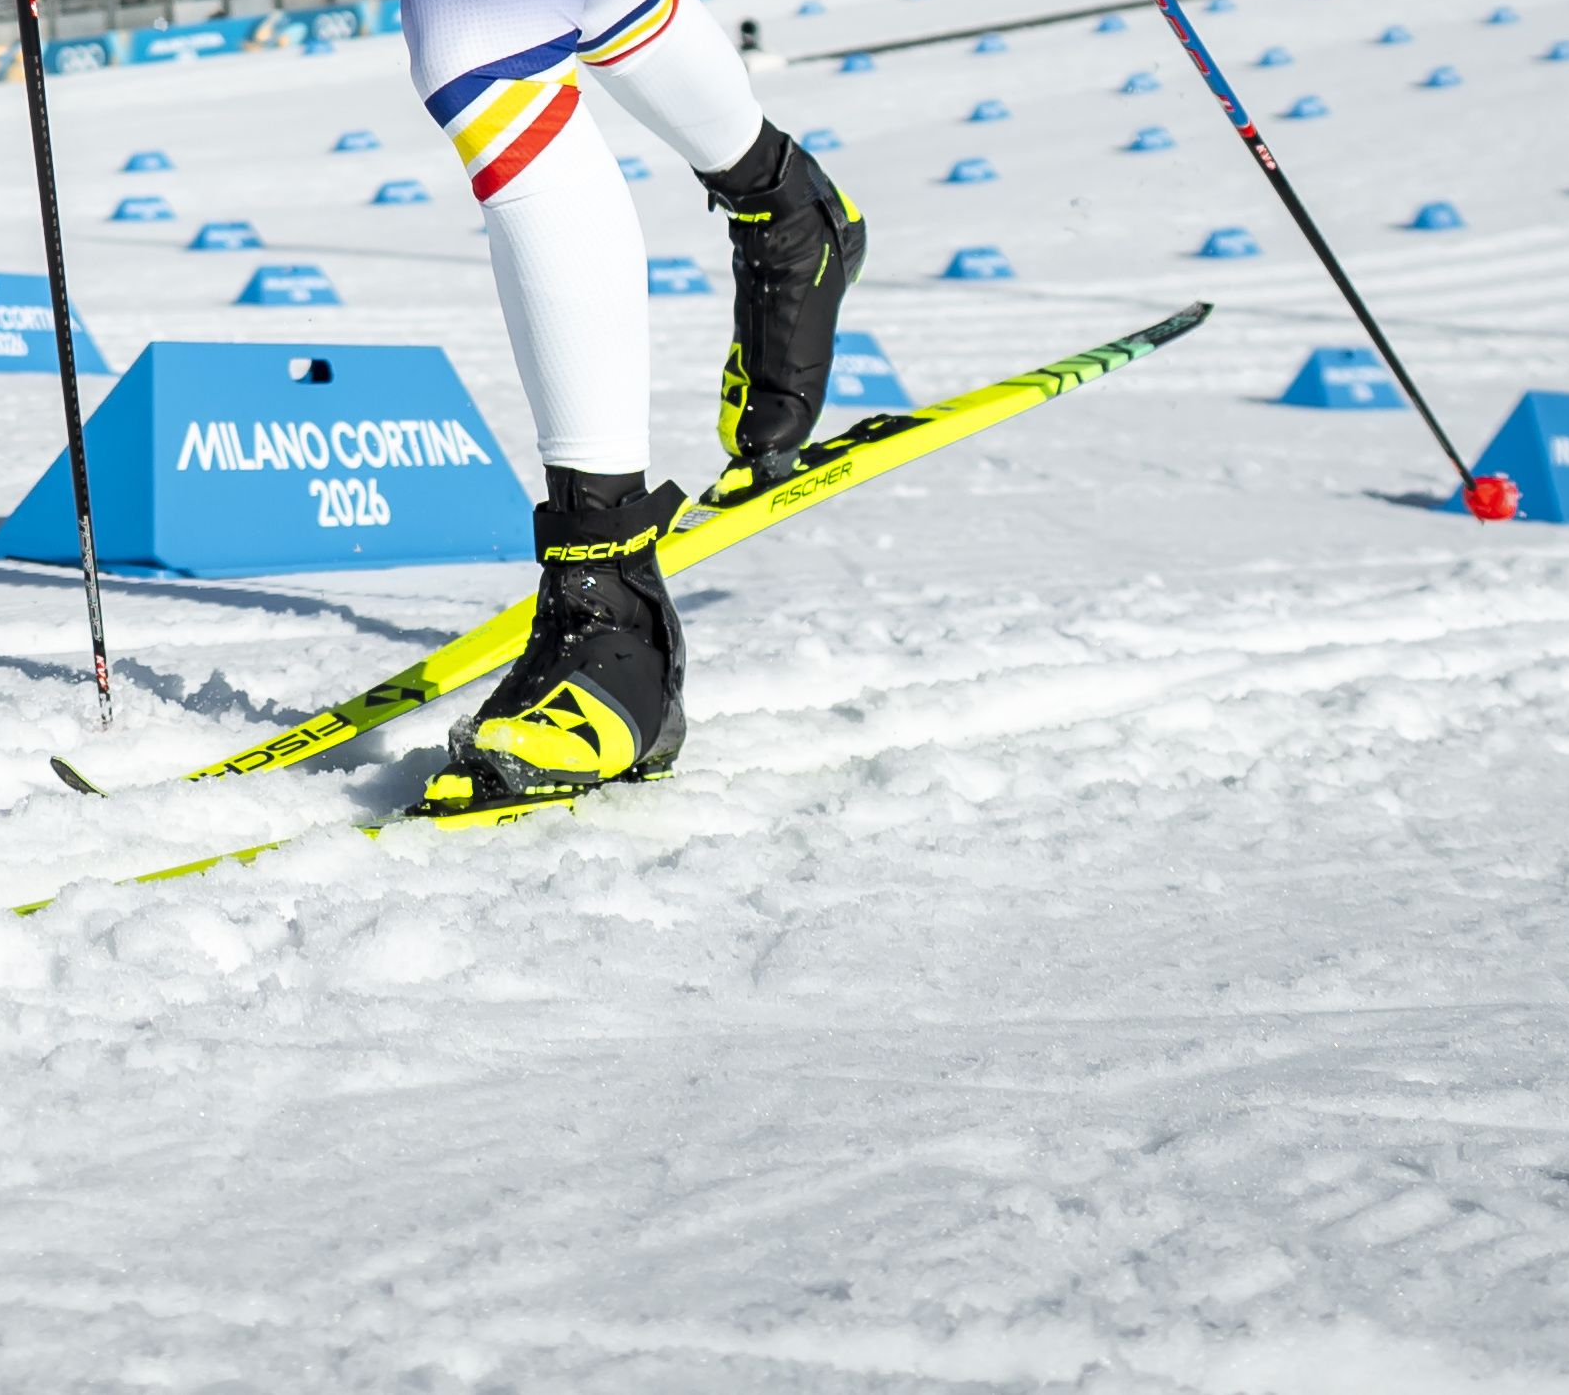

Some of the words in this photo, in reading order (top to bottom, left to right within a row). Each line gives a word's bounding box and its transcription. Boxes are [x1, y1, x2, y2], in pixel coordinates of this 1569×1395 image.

[176, 420, 330, 471] MILANO
[330, 418, 492, 469] CORTINA
[309, 477, 391, 527] 2026
[770, 461, 853, 513] FISCHER
[543, 524, 658, 562] FISCHER
[188, 711, 354, 783] FISCH
